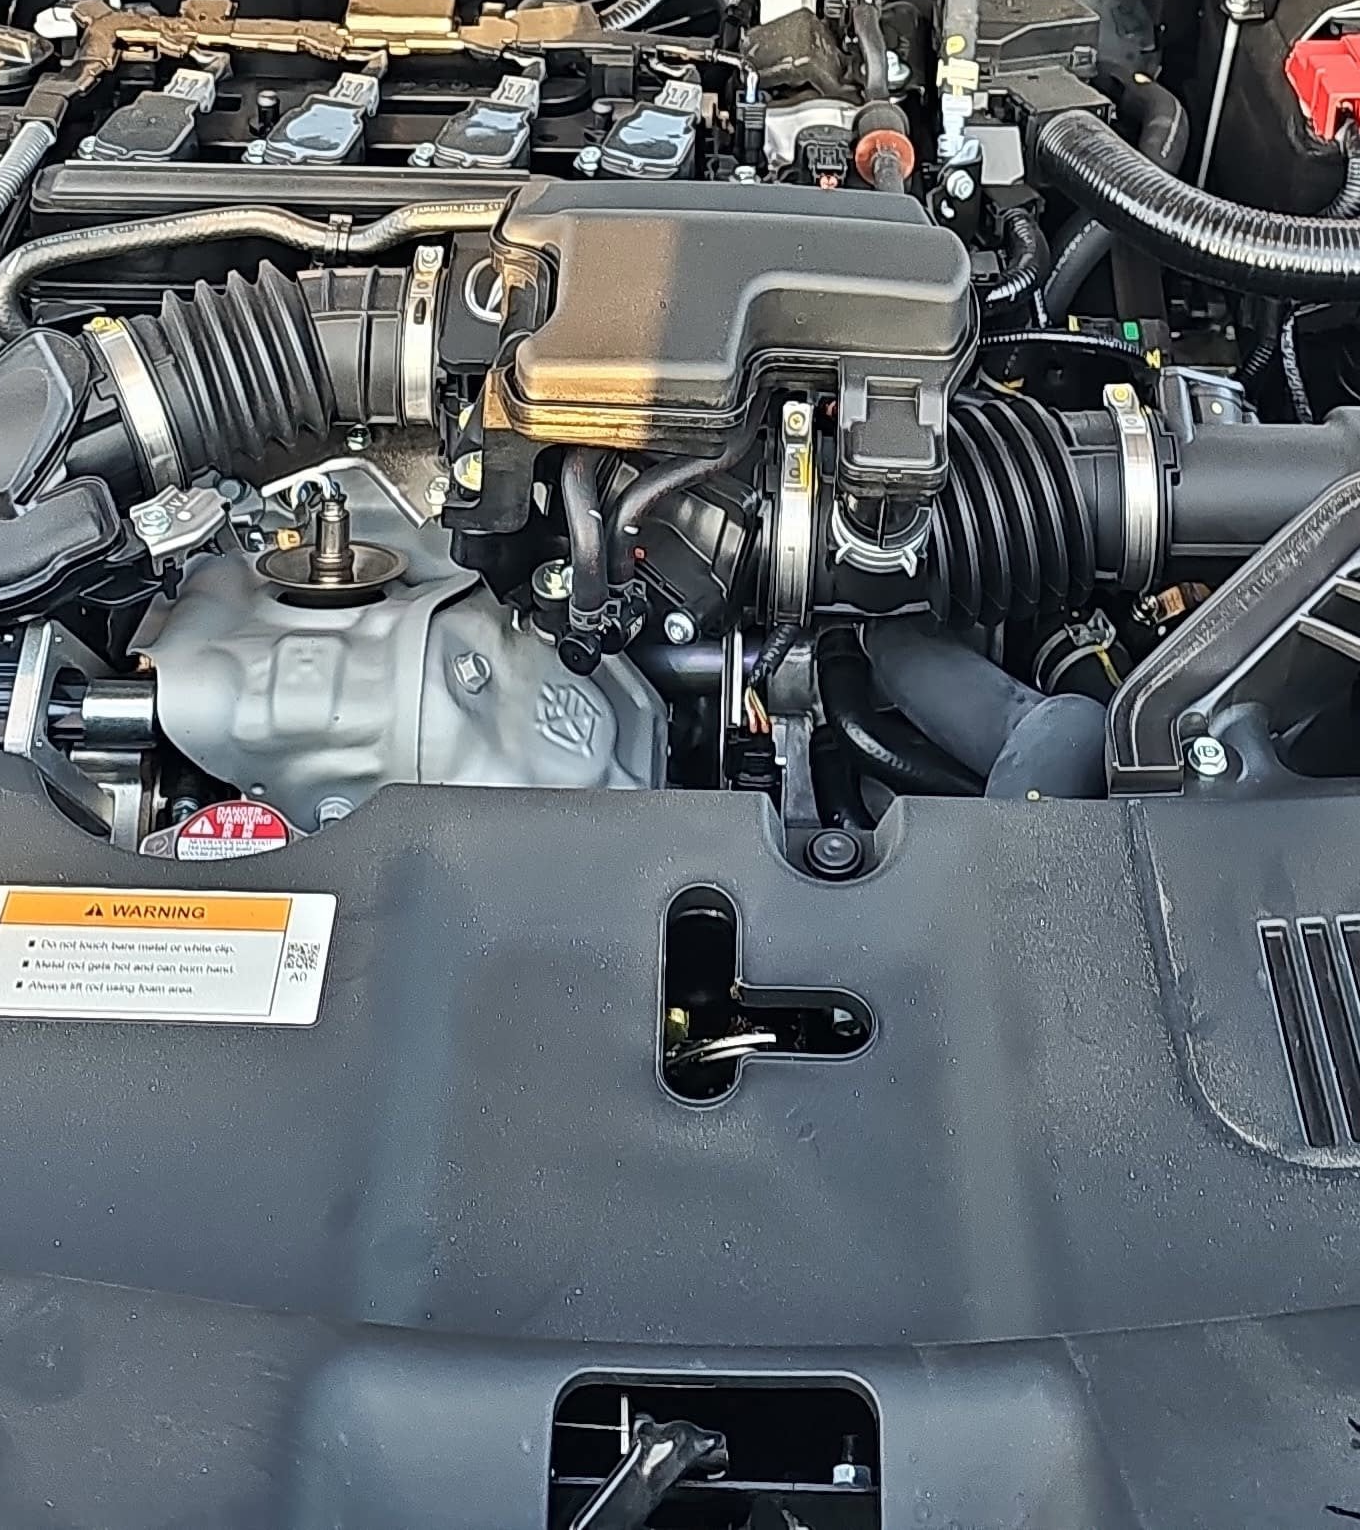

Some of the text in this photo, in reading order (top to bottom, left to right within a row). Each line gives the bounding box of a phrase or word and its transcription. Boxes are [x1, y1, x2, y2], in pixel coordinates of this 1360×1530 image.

[216, 806, 264, 816] DANGER
[112, 904, 206, 919] WARNING
[41, 939, 56, 949] Do
[59, 940, 76, 950] not
[79, 941, 108, 951] touch
[111, 942, 135, 951] bare
[138, 943, 168, 952] metal
[170, 944, 182, 952] or
[184, 944, 212, 952] white
[35, 959, 65, 969] Metal
[67, 961, 85, 970] rod
[87, 961, 110, 972] gets
[114, 962, 130, 971] hot
[133, 963, 153, 972] and
[156, 964, 176, 972] can
[179, 963, 203, 974] burn
[28, 980, 66, 991] Always
[85, 983, 103, 992] rod
[106, 983, 135, 993] using
[139, 983, 165, 993] foam
